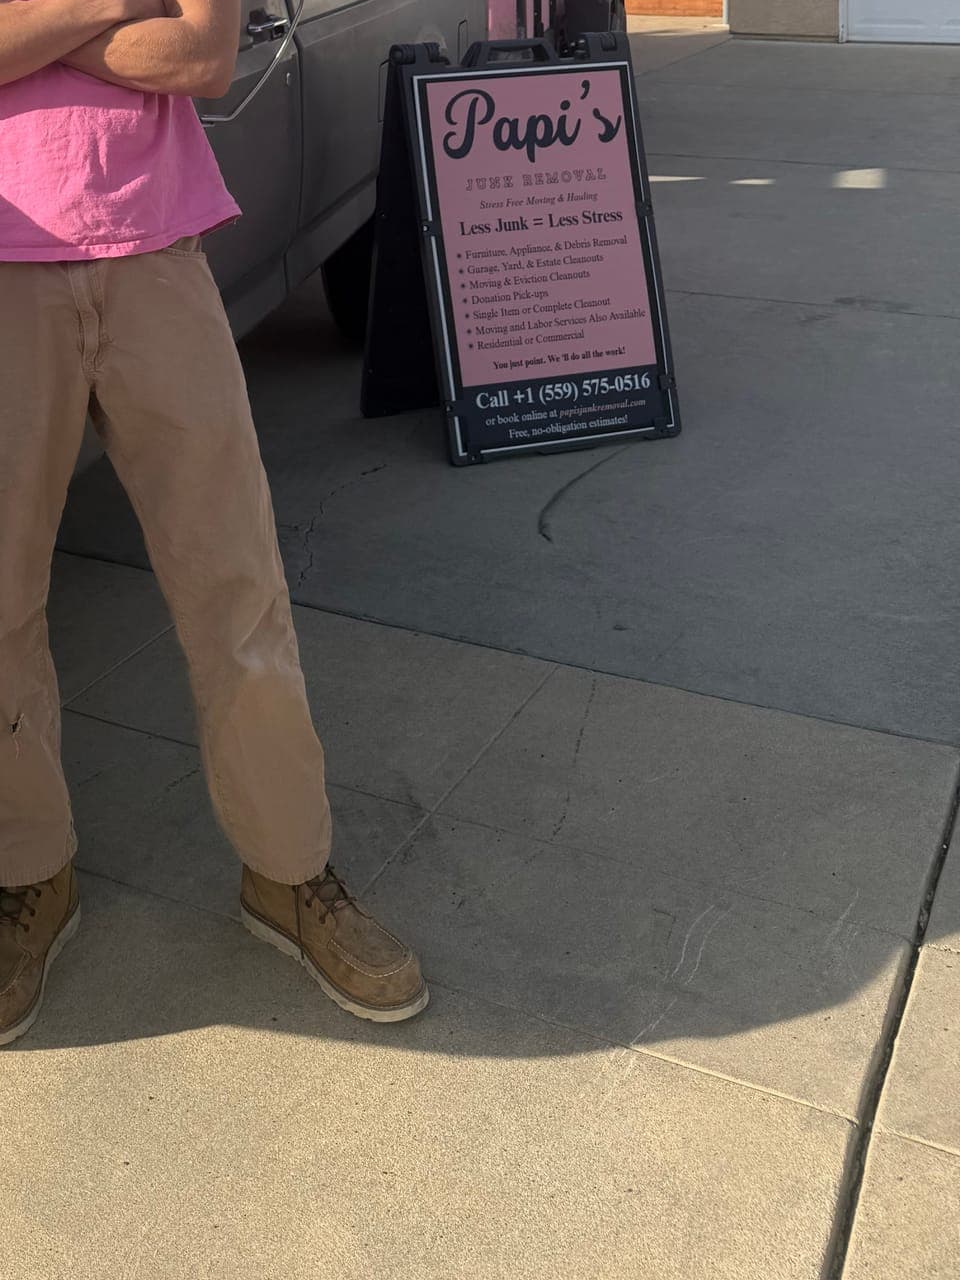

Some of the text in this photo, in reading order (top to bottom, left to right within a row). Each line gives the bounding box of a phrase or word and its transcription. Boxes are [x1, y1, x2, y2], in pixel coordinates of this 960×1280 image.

[443, 80, 622, 163] Papi's
[465, 168, 607, 191] JUNK REMOVAL
[480, 191, 598, 210] Stress Free Moving & Hauling
[460, 221, 491, 236] Less
[495, 216, 529, 232] Junk
[548, 213, 579, 228] Less
[582, 210, 623, 224] Stress
[465, 235, 628, 259] Furniture, Appliance, & Debris Removal
[467, 254, 604, 275] Garage, Yard, & Estate Cleanouts
[469, 270, 590, 290] Moving & Eviction Cleanouts
[471, 289, 549, 305] Donation Pick-ups
[473, 309, 498, 320] Single
[500, 307, 520, 317] Item
[533, 302, 572, 313] Complete
[574, 298, 610, 308] Cleanout
[475, 309, 646, 335] Moving and Labor Services Also Available
[477, 329, 585, 350] Residential or Commercial
[493, 361, 508, 370] You
[509, 359, 523, 370] just
[525, 357, 546, 368] point.
[548, 354, 560, 363] We
[571, 352, 580, 360] do
[581, 351, 591, 359] all
[592, 349, 604, 358] the
[605, 346, 626, 356] work!
[476, 372, 651, 409] Call +1 (559) 575-0516
[485, 418, 495, 426] or
[497, 413, 520, 424] book
[521, 410, 548, 421] online
[549, 409, 558, 418] at
[509, 414, 628, 439] Free, no-obligation estimates!
